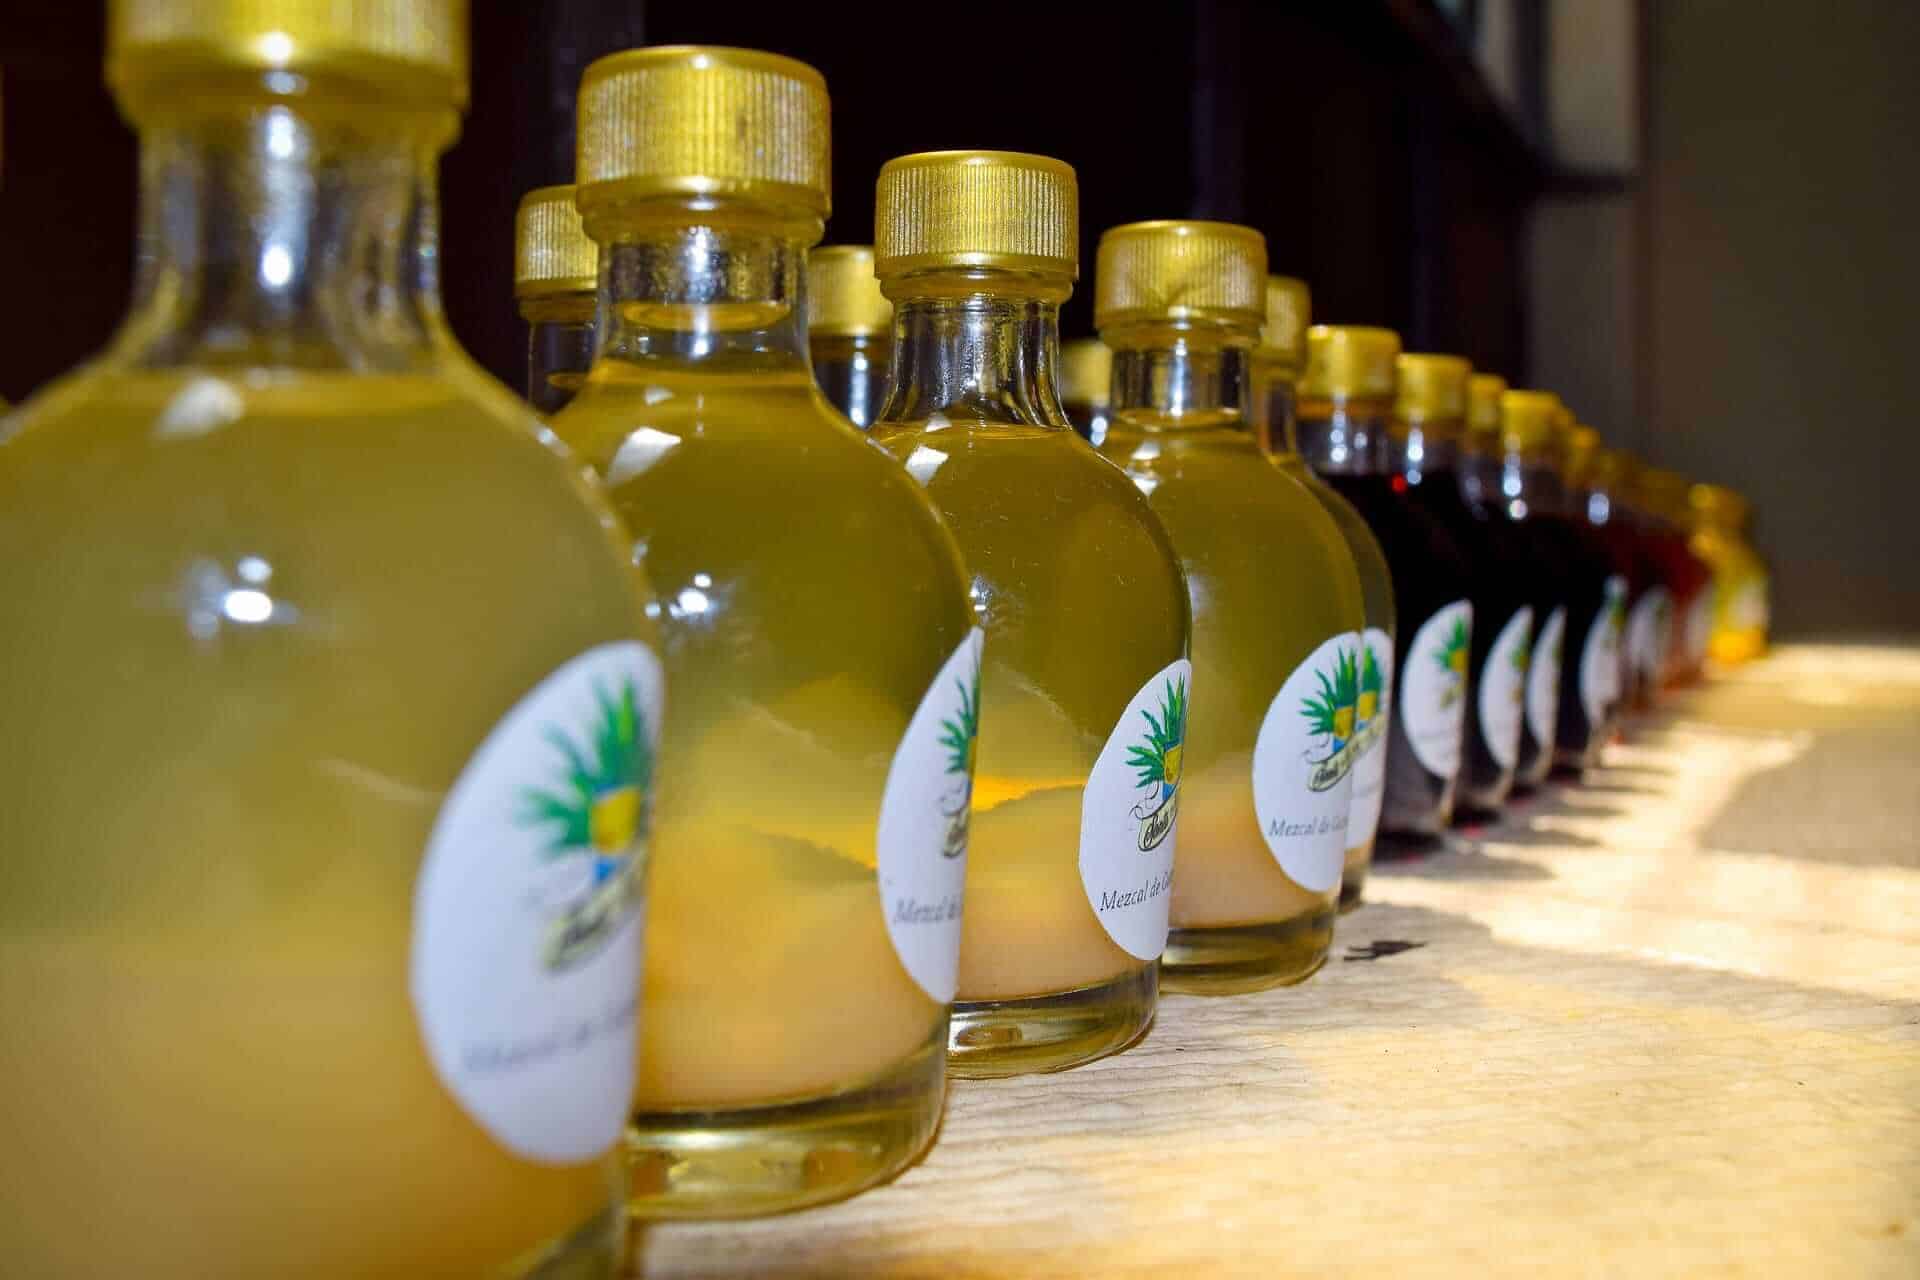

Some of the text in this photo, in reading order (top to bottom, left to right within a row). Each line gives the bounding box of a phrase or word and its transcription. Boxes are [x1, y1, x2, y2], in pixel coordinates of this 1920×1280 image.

[1269, 816, 1316, 836] Mezcal
[1100, 879, 1149, 911] Mezcal
[1149, 876, 1161, 897] de
